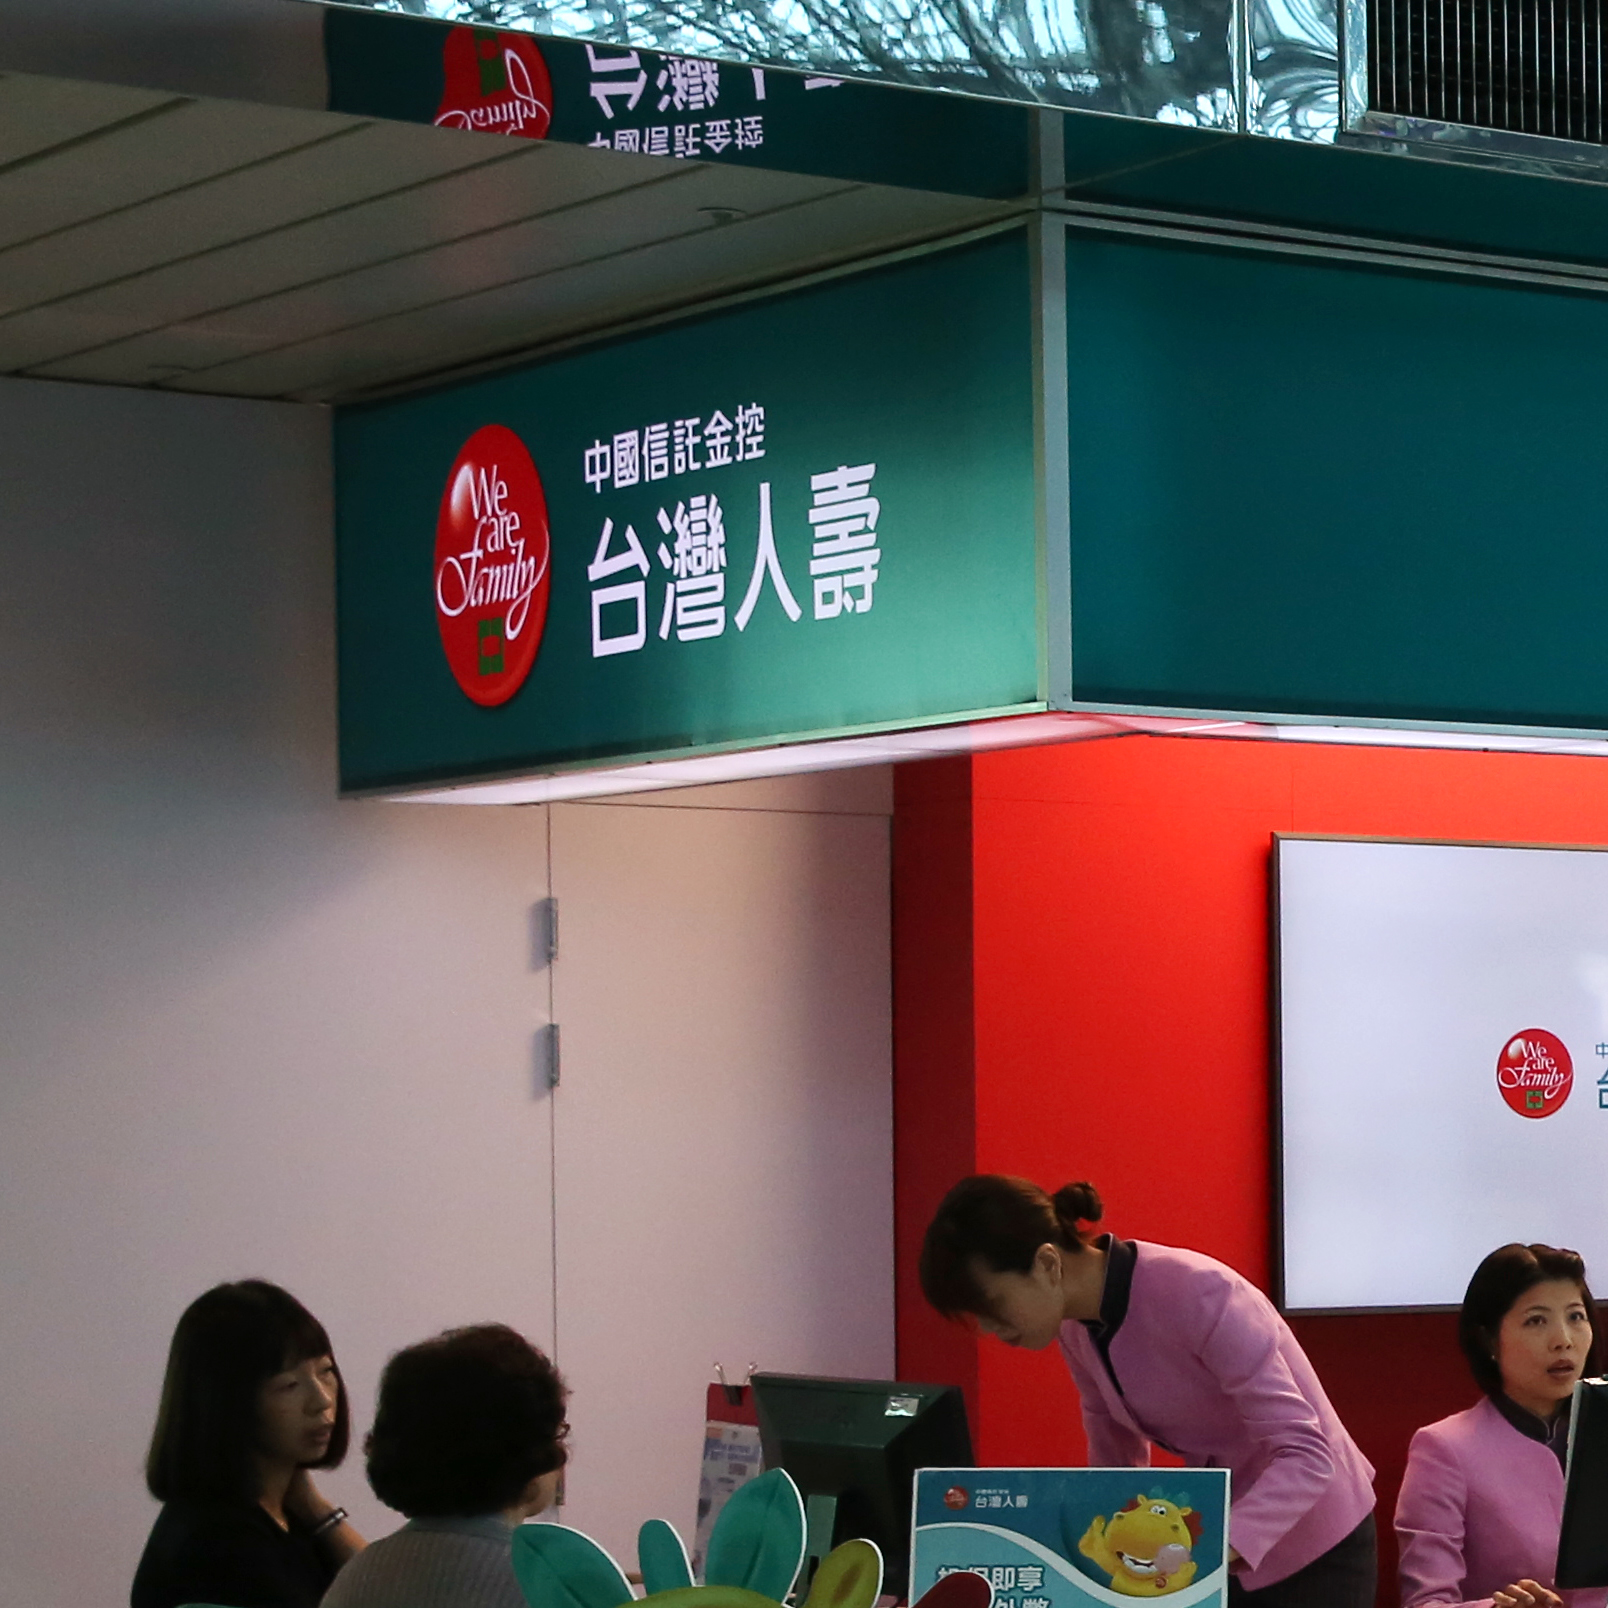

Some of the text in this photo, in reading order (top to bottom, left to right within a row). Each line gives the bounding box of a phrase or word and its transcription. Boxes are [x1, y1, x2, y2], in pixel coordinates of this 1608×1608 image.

[583, 403, 767, 493] 中國信託金控
[467, 463, 509, 521] We
[487, 516, 521, 552] are
[587, 462, 882, 658] 台灣人壽
[1521, 1041, 1547, 1060] We
